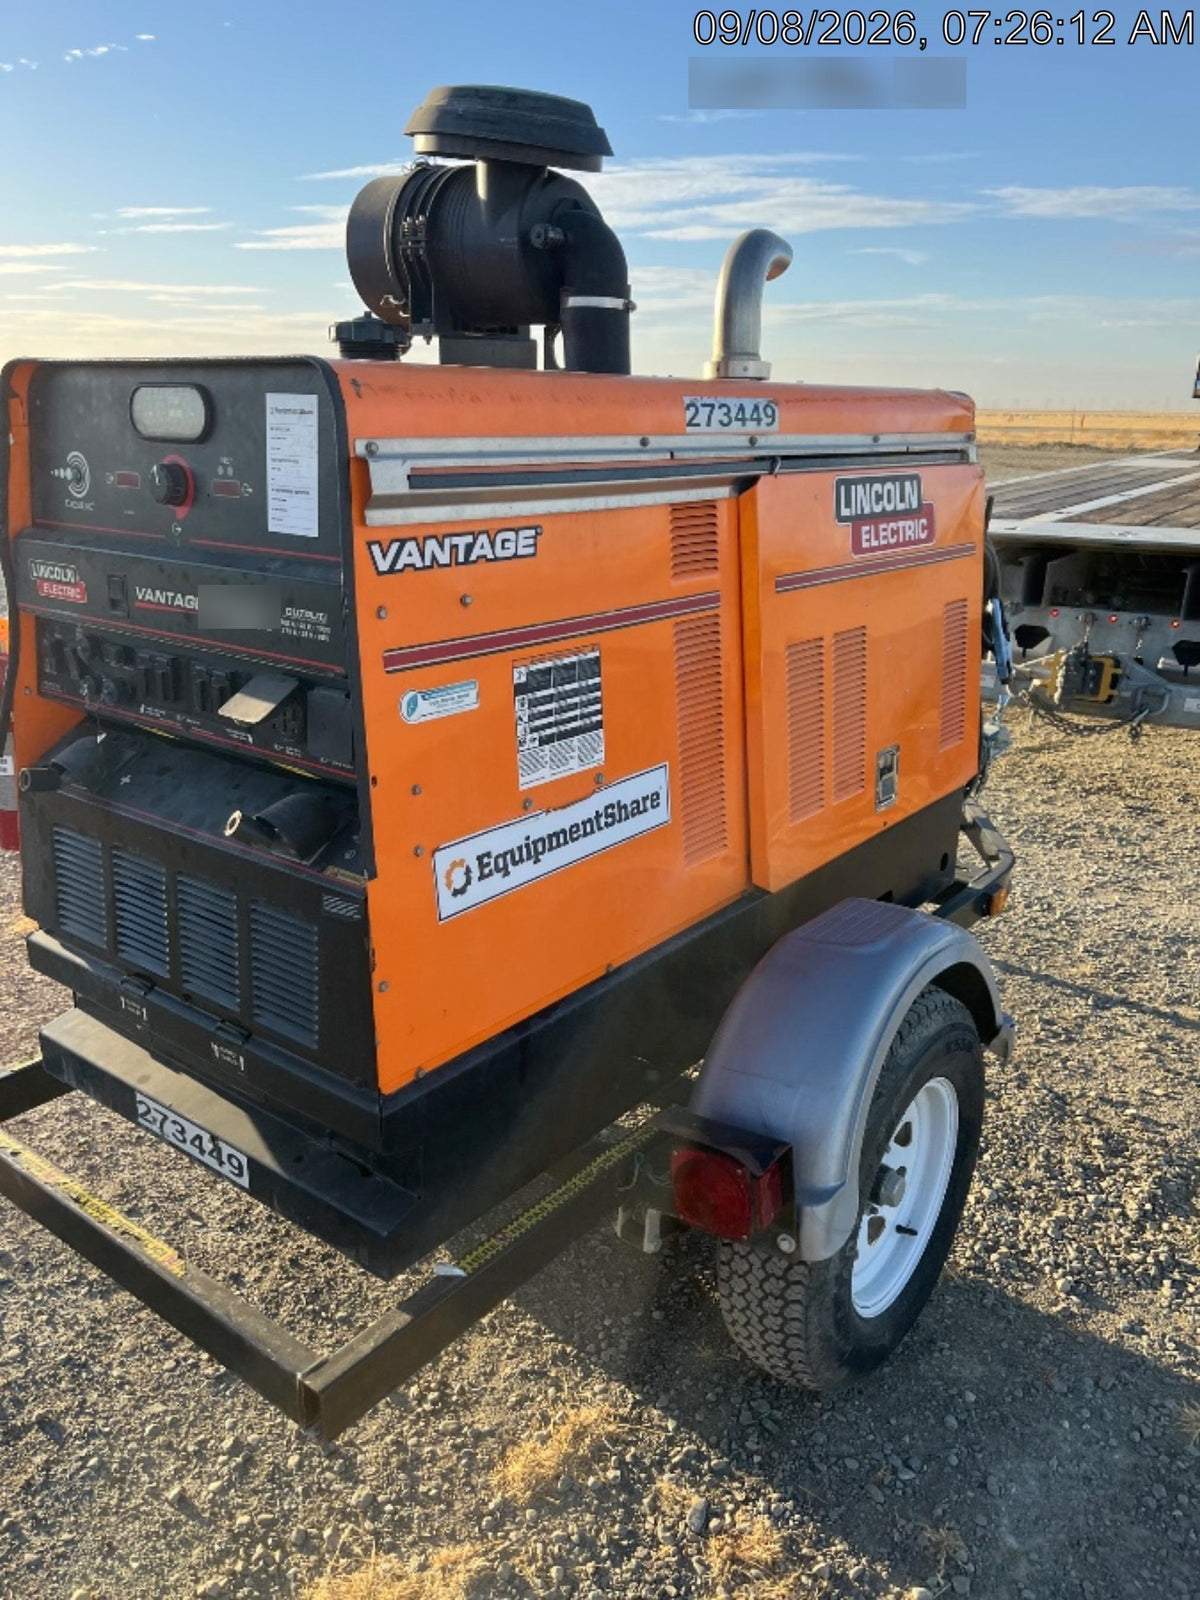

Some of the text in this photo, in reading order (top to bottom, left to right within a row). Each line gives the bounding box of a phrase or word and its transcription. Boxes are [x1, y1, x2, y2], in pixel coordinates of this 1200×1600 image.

[685, 402, 776, 428] 273449
[840, 480, 918, 516] LINCOLN
[861, 518, 928, 548] ELECTRIC
[31, 562, 76, 583] LINCOLN
[43, 582, 80, 598] ELECTRIC
[475, 790, 662, 882] EquipmentShare
[137, 1100, 246, 1178] 273449
